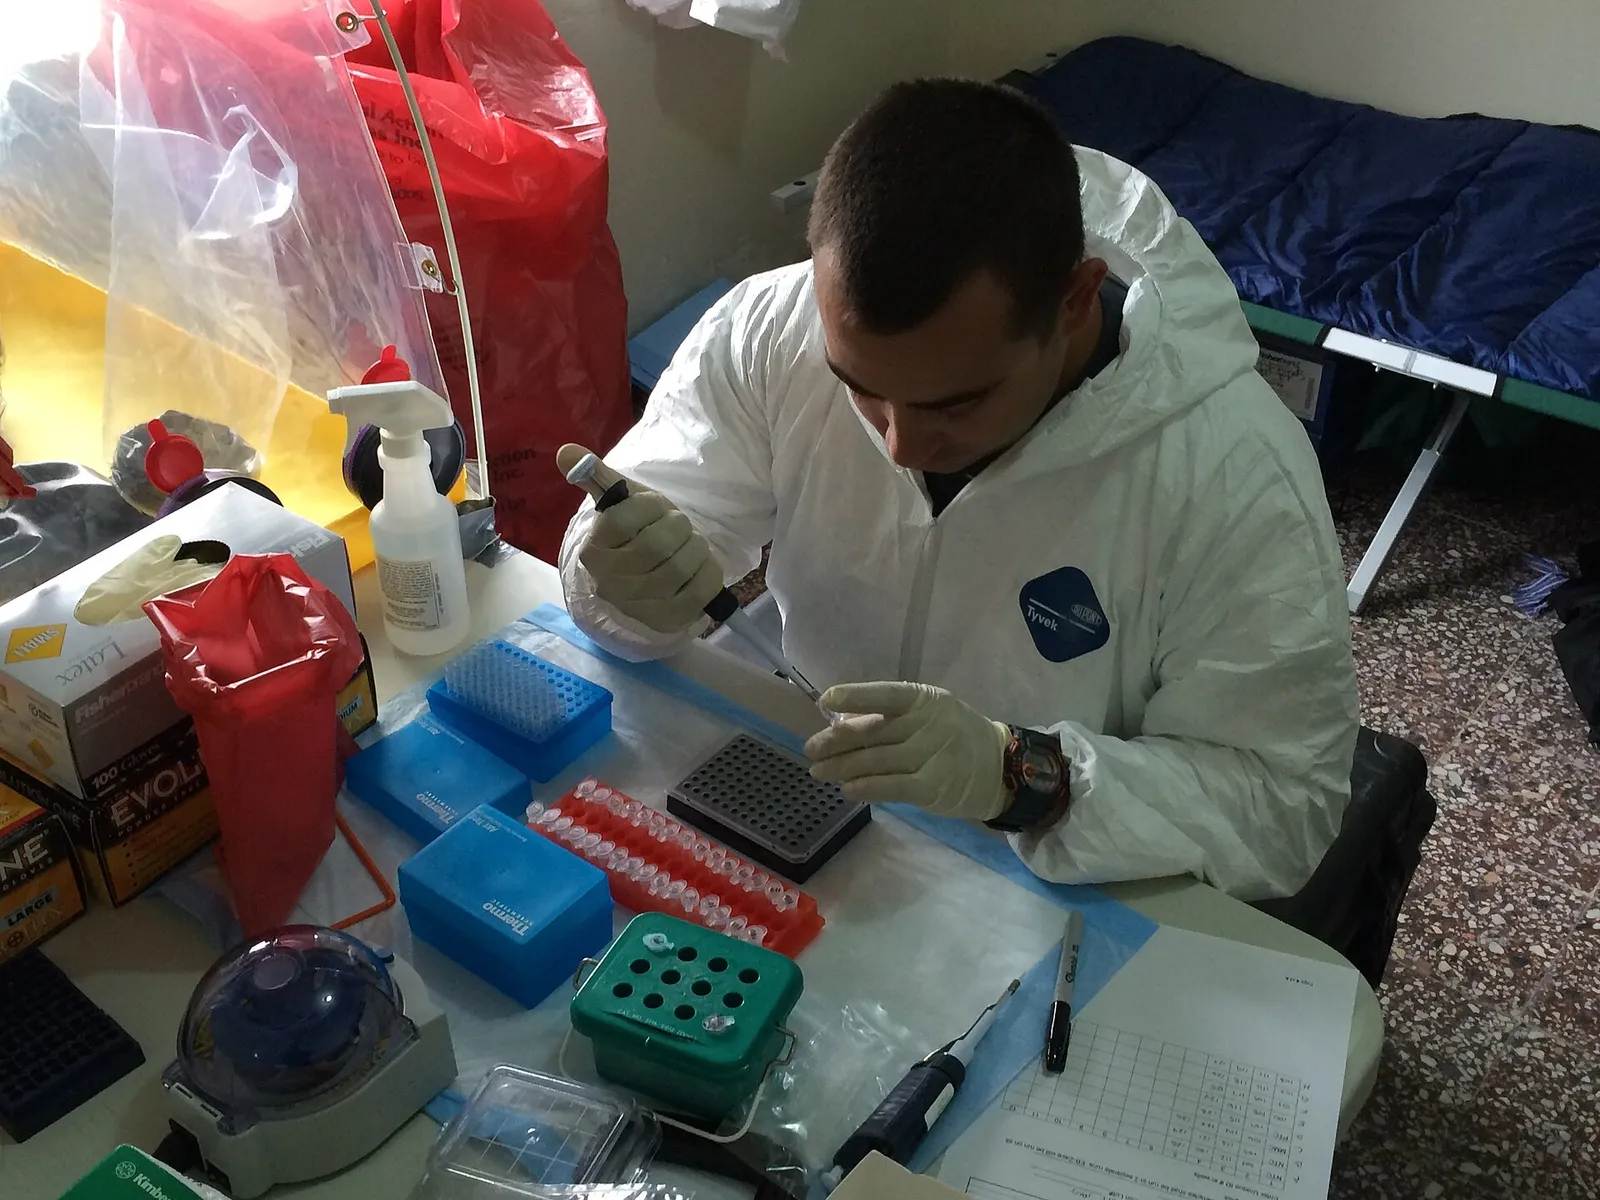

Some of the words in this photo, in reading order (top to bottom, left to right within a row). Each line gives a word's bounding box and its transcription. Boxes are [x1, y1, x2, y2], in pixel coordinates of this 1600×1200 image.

[1027, 605, 1059, 631] Tyvek
[55, 641, 125, 686] Latex
[92, 766, 119, 790] 100
[416, 793, 454, 824] Thermo
[6, 893, 54, 927] LARGE
[482, 902, 530, 937] Thermo
[1009, 1104, 1016, 1112] 12
[1054, 1117, 1062, 1125] 10
